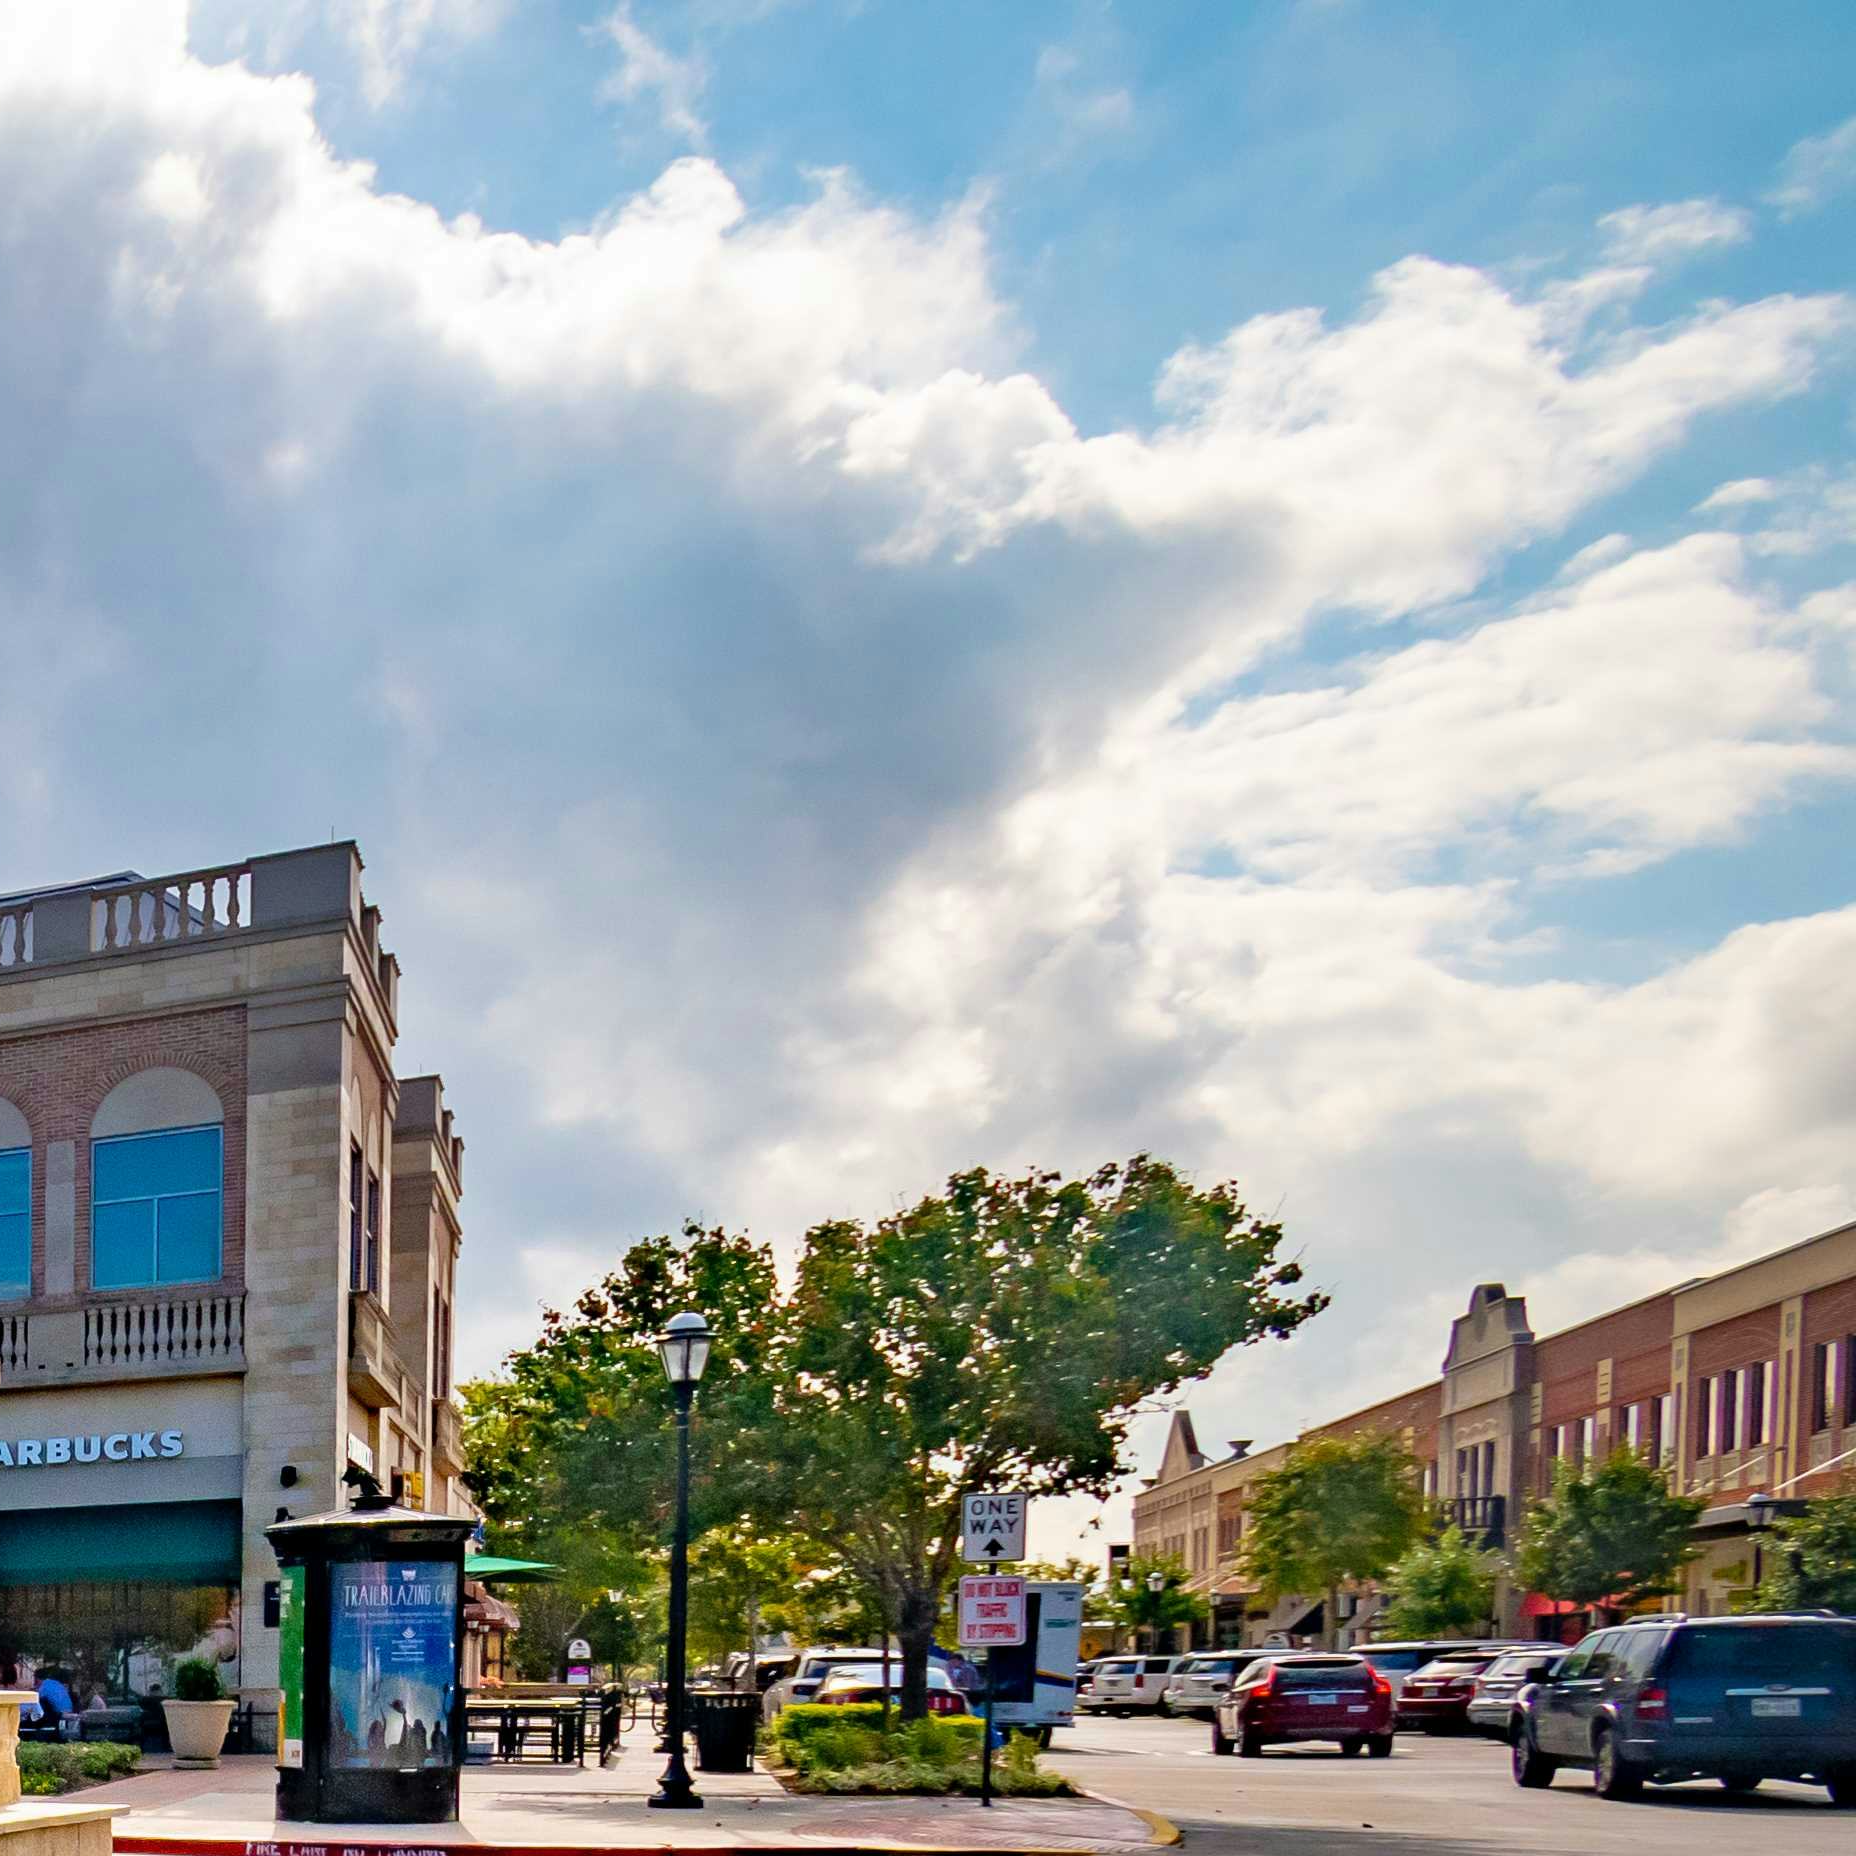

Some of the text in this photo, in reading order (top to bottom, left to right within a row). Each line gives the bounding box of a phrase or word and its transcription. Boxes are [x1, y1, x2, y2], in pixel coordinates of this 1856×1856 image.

[970, 1499, 1019, 1516] ONE
[969, 1518, 1020, 1535] WAY
[343, 1584, 432, 1607] TRAILBLAZING
